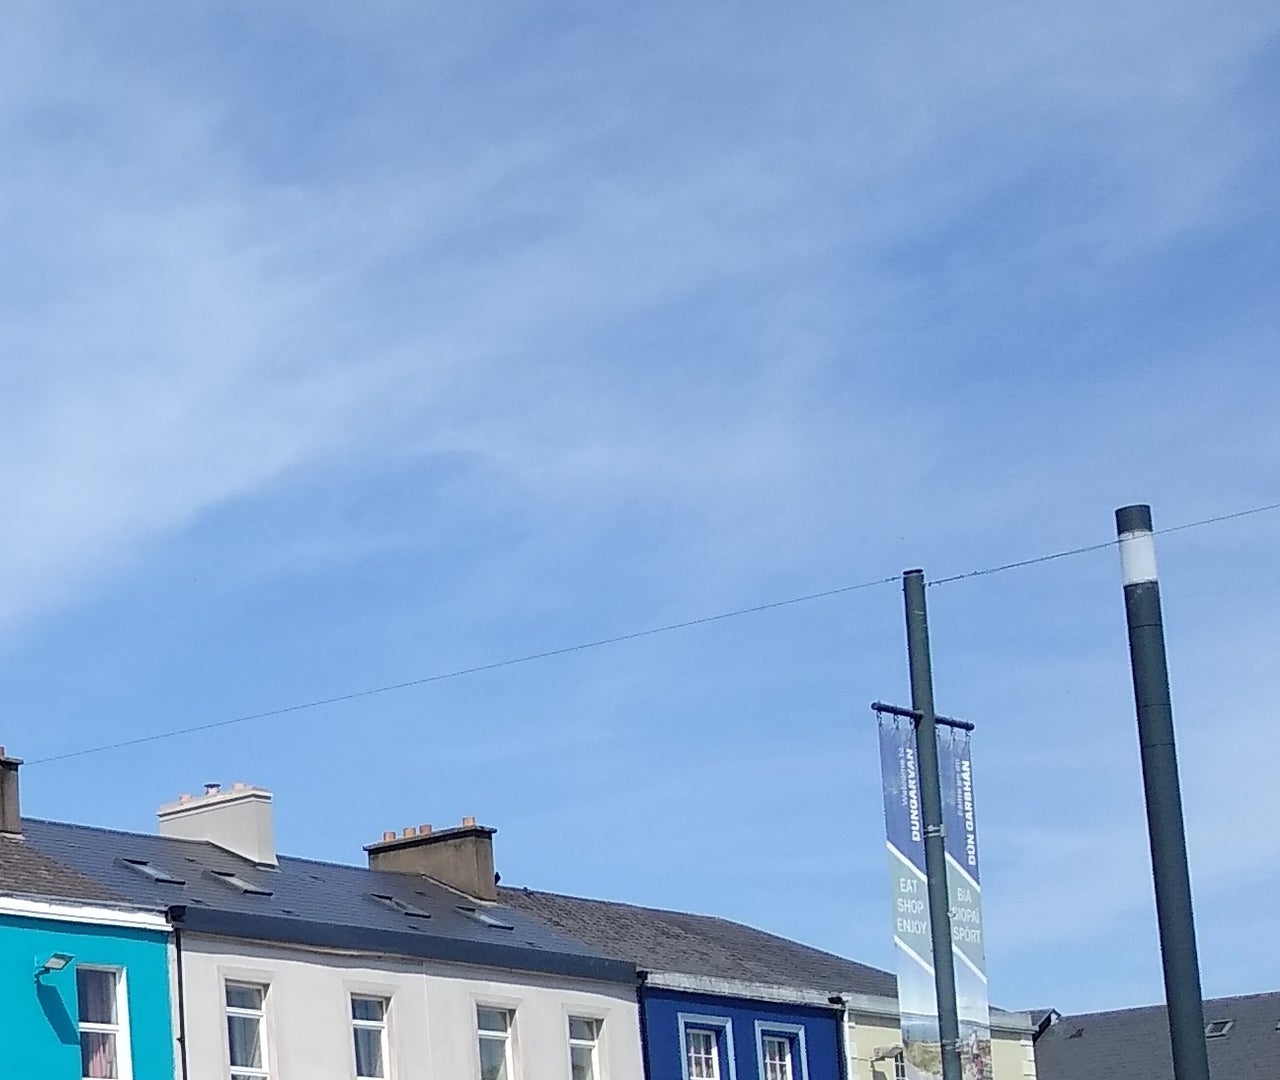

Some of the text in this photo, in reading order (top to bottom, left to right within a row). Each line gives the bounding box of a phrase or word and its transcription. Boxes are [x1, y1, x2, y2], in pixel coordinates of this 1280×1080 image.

[906, 748, 920, 842] DUNGARVAN
[900, 878, 918, 893] EAT
[957, 887, 972, 902] BIA
[897, 898, 924, 914] SHOP
[897, 918, 927, 934] ENJOY
